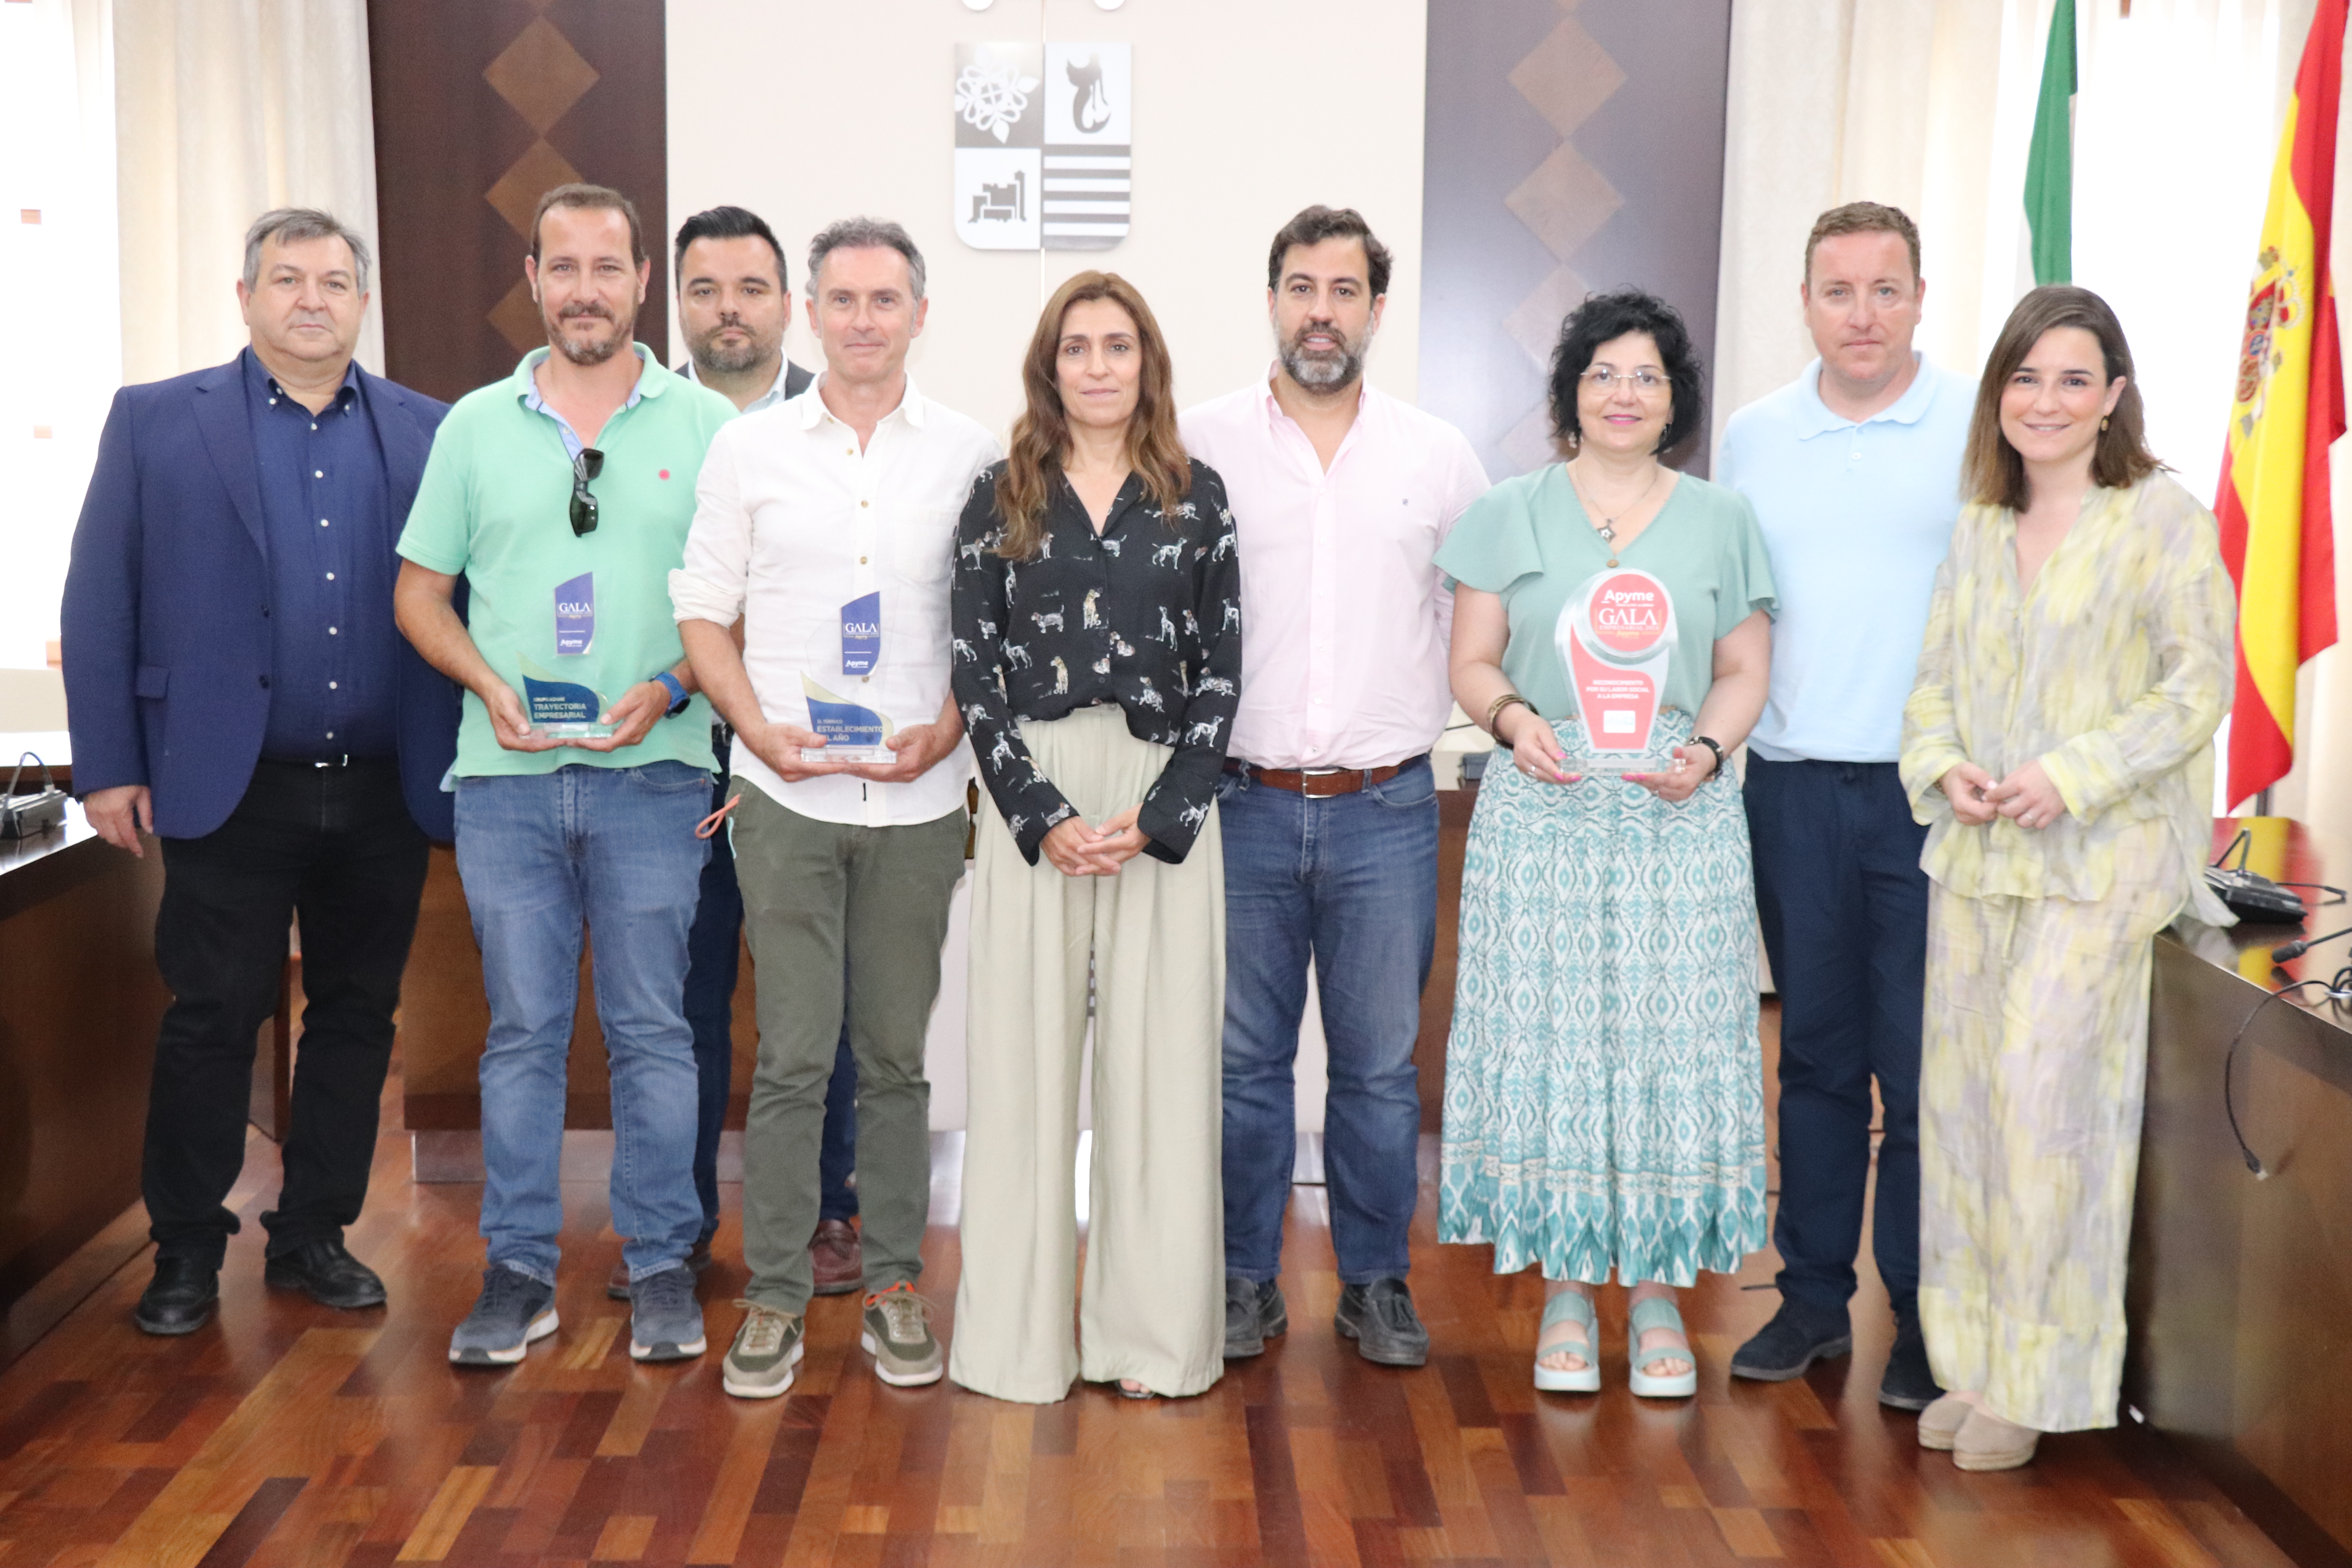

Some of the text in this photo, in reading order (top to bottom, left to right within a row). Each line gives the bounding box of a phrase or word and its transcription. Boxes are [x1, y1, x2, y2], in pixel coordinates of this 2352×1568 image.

[1604, 589, 1654, 603] Apyme
[559, 603, 591, 612] GALA
[1599, 608, 1658, 625] GALA
[845, 622, 877, 632] GALA
[833, 733, 849, 741] AÑO
